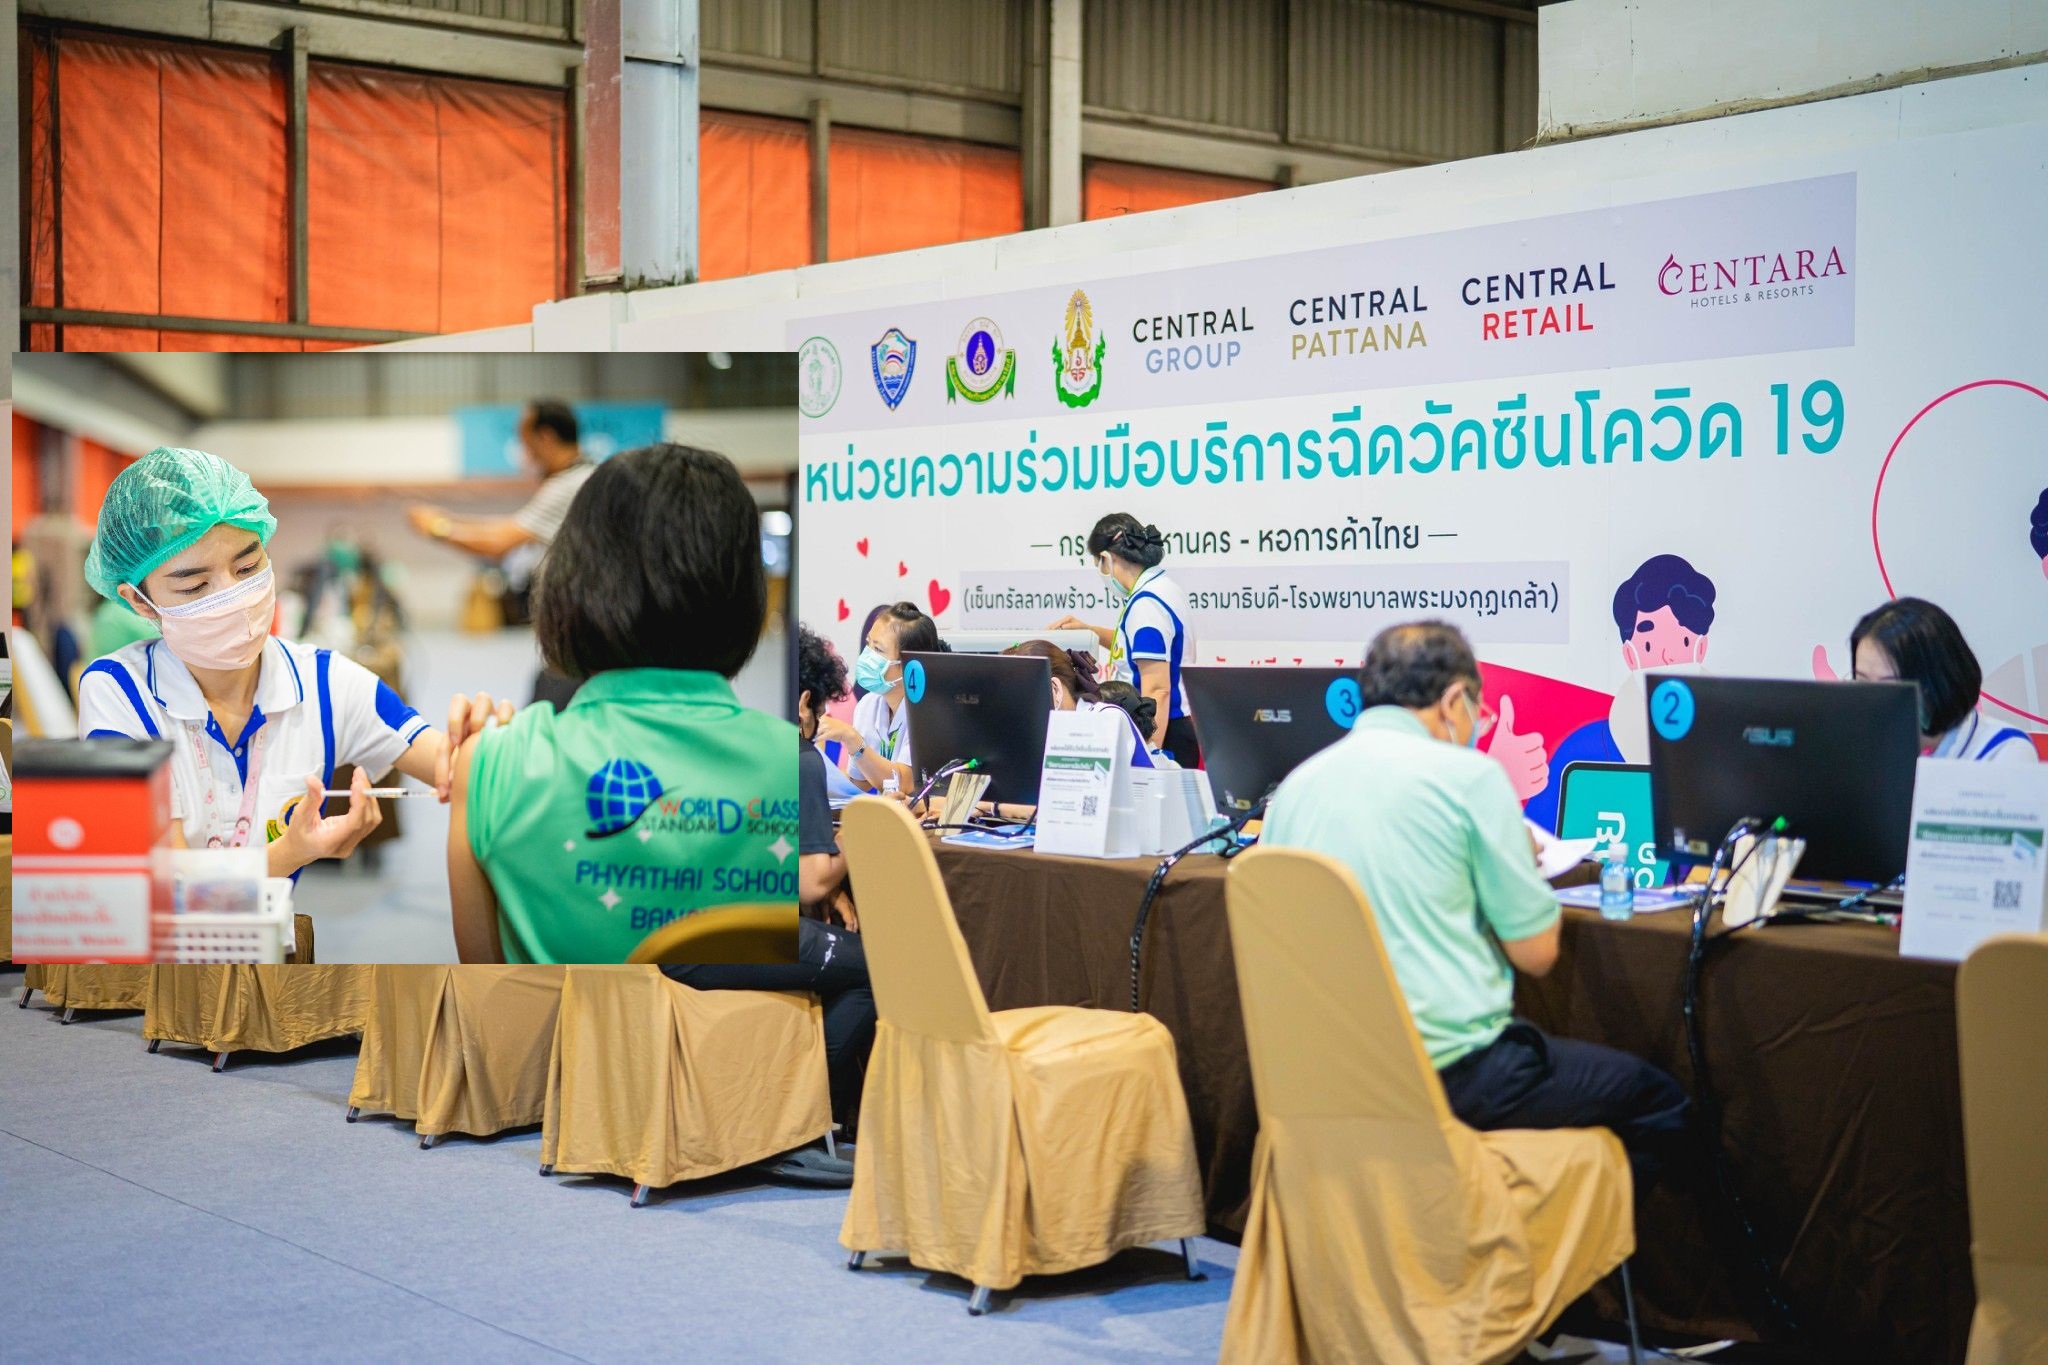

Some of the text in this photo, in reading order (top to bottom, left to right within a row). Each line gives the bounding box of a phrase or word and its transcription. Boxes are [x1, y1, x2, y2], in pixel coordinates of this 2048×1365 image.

[1461, 261, 1616, 306] CENTRAL
[1657, 245, 1847, 296] CENTARA
[1289, 285, 1428, 326] CENTRAL
[1690, 285, 1815, 309] HOTELS & RESORTS
[1133, 306, 1254, 343] CENTRAL
[1291, 320, 1428, 360] PATTANA
[1483, 303, 1594, 341] RETAIL
[1145, 340, 1241, 374] GROUP
[806, 379, 1845, 502] หน่วยความร่วมมือบริการฉีดวัคซีนโควิด 19
[1258, 516, 1420, 552] หอการค้าไทย
[1253, 708, 1293, 723] ASUS
[1339, 688, 1357, 718] 3
[1663, 691, 1680, 725] 2
[747, 818, 799, 837] SCHOO
[575, 859, 704, 892] PHYATHAI
